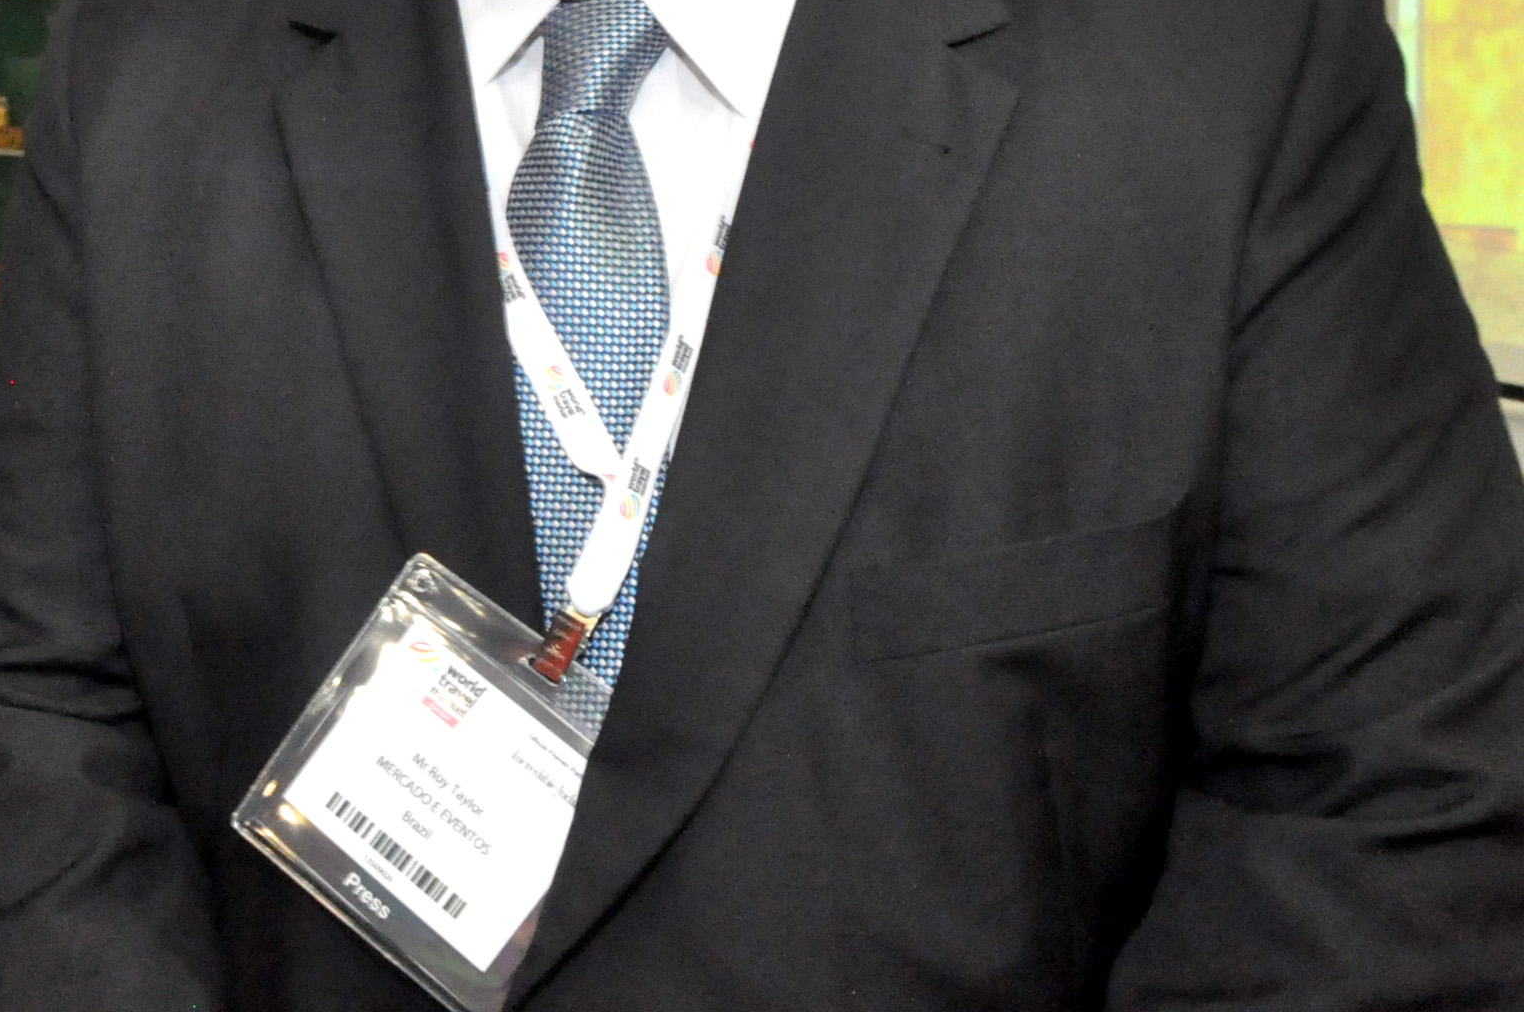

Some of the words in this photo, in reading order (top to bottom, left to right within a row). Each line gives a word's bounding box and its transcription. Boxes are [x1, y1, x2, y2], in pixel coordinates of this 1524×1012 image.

[438, 674, 477, 709] travel
[447, 665, 488, 698] world
[376, 756, 433, 805] MERCADO
[431, 801, 441, 813] E
[439, 809, 492, 855] EVENTOS
[412, 753, 429, 770] Mr
[428, 766, 450, 789] Roy
[451, 784, 484, 816] Taylor
[402, 810, 434, 840] Brazil
[342, 871, 391, 920] Press
